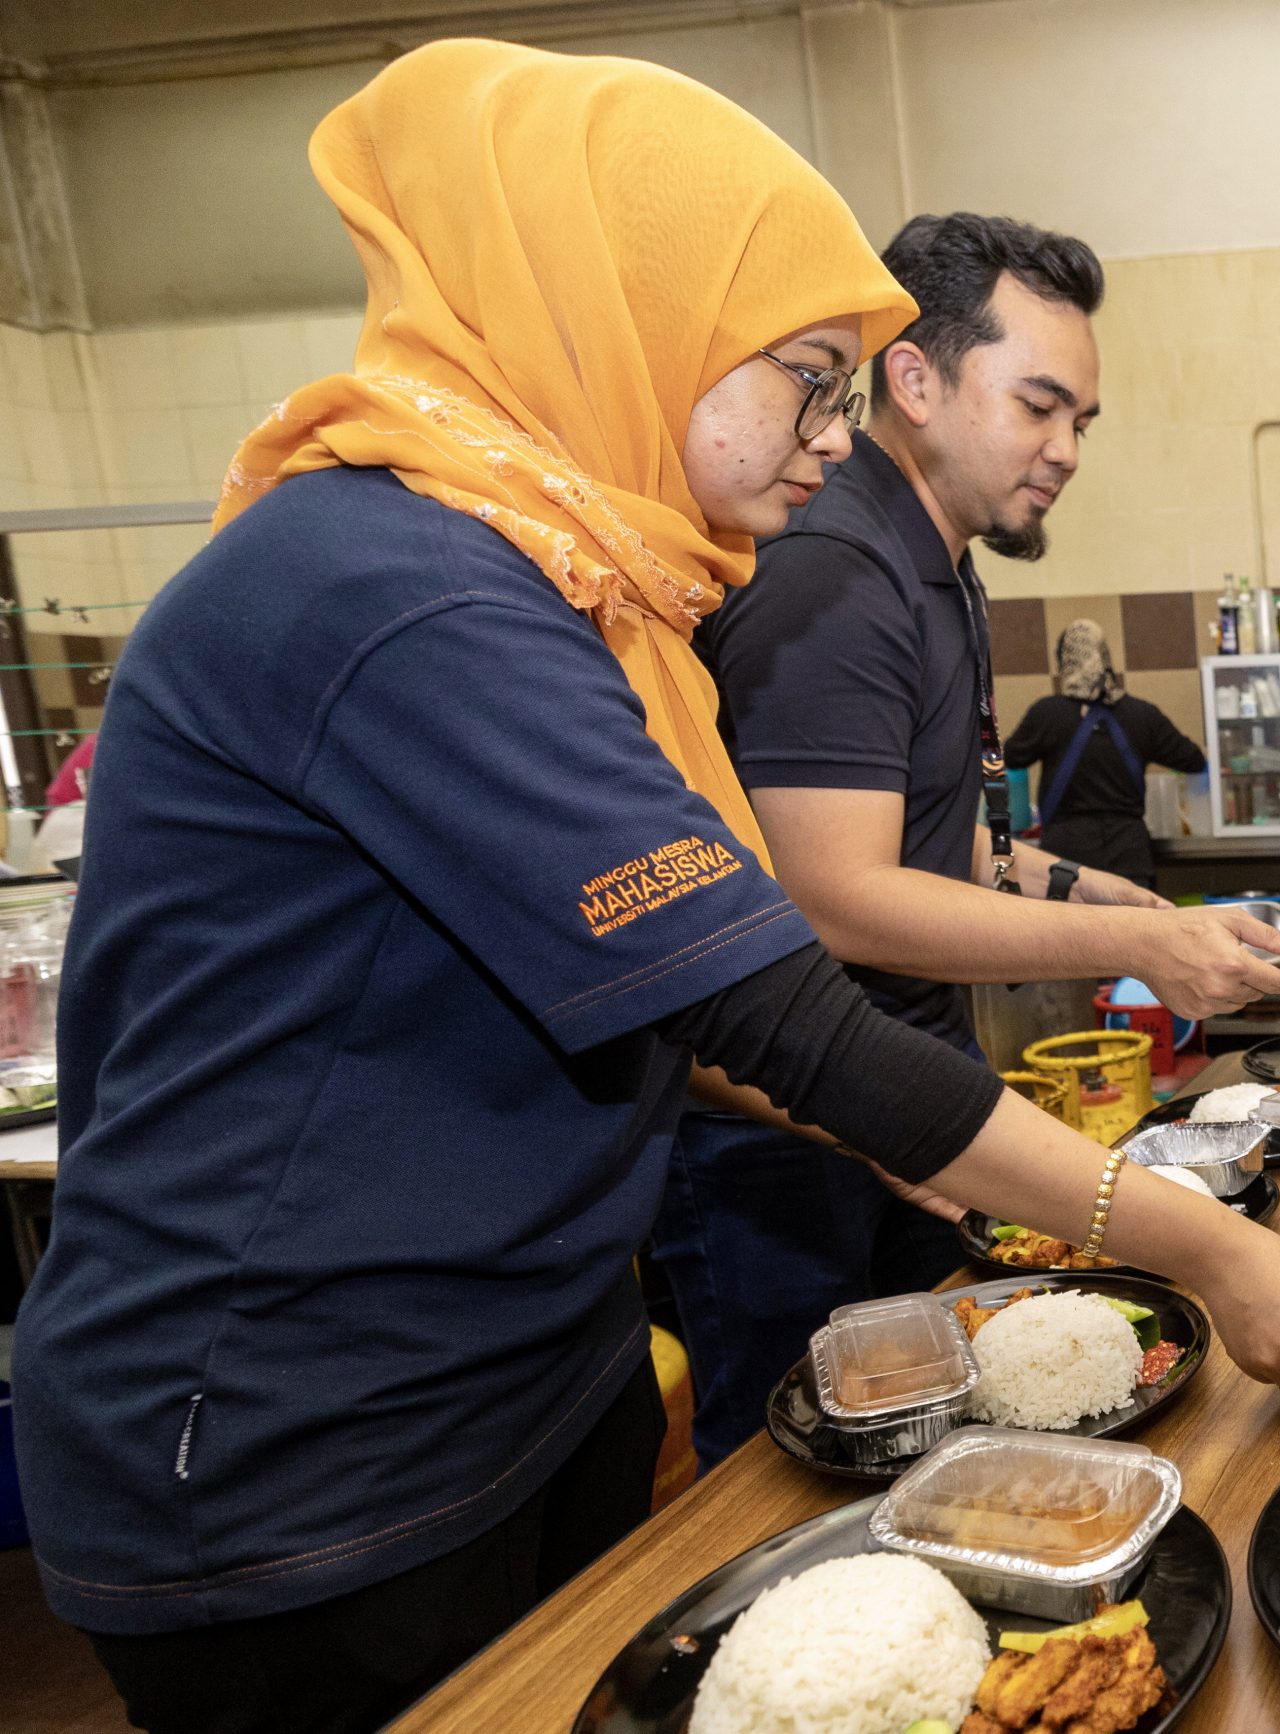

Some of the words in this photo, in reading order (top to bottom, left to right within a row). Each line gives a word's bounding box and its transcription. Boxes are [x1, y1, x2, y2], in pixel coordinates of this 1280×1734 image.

[578, 841, 735, 927] MAHASISWA
[582, 856, 649, 897] MINGGU
[649, 835, 704, 866] MESRA
[591, 904, 647, 938] UNIVERSITI
[645, 880, 699, 912] MALAYSIA
[696, 859, 743, 887] KELANTAN
